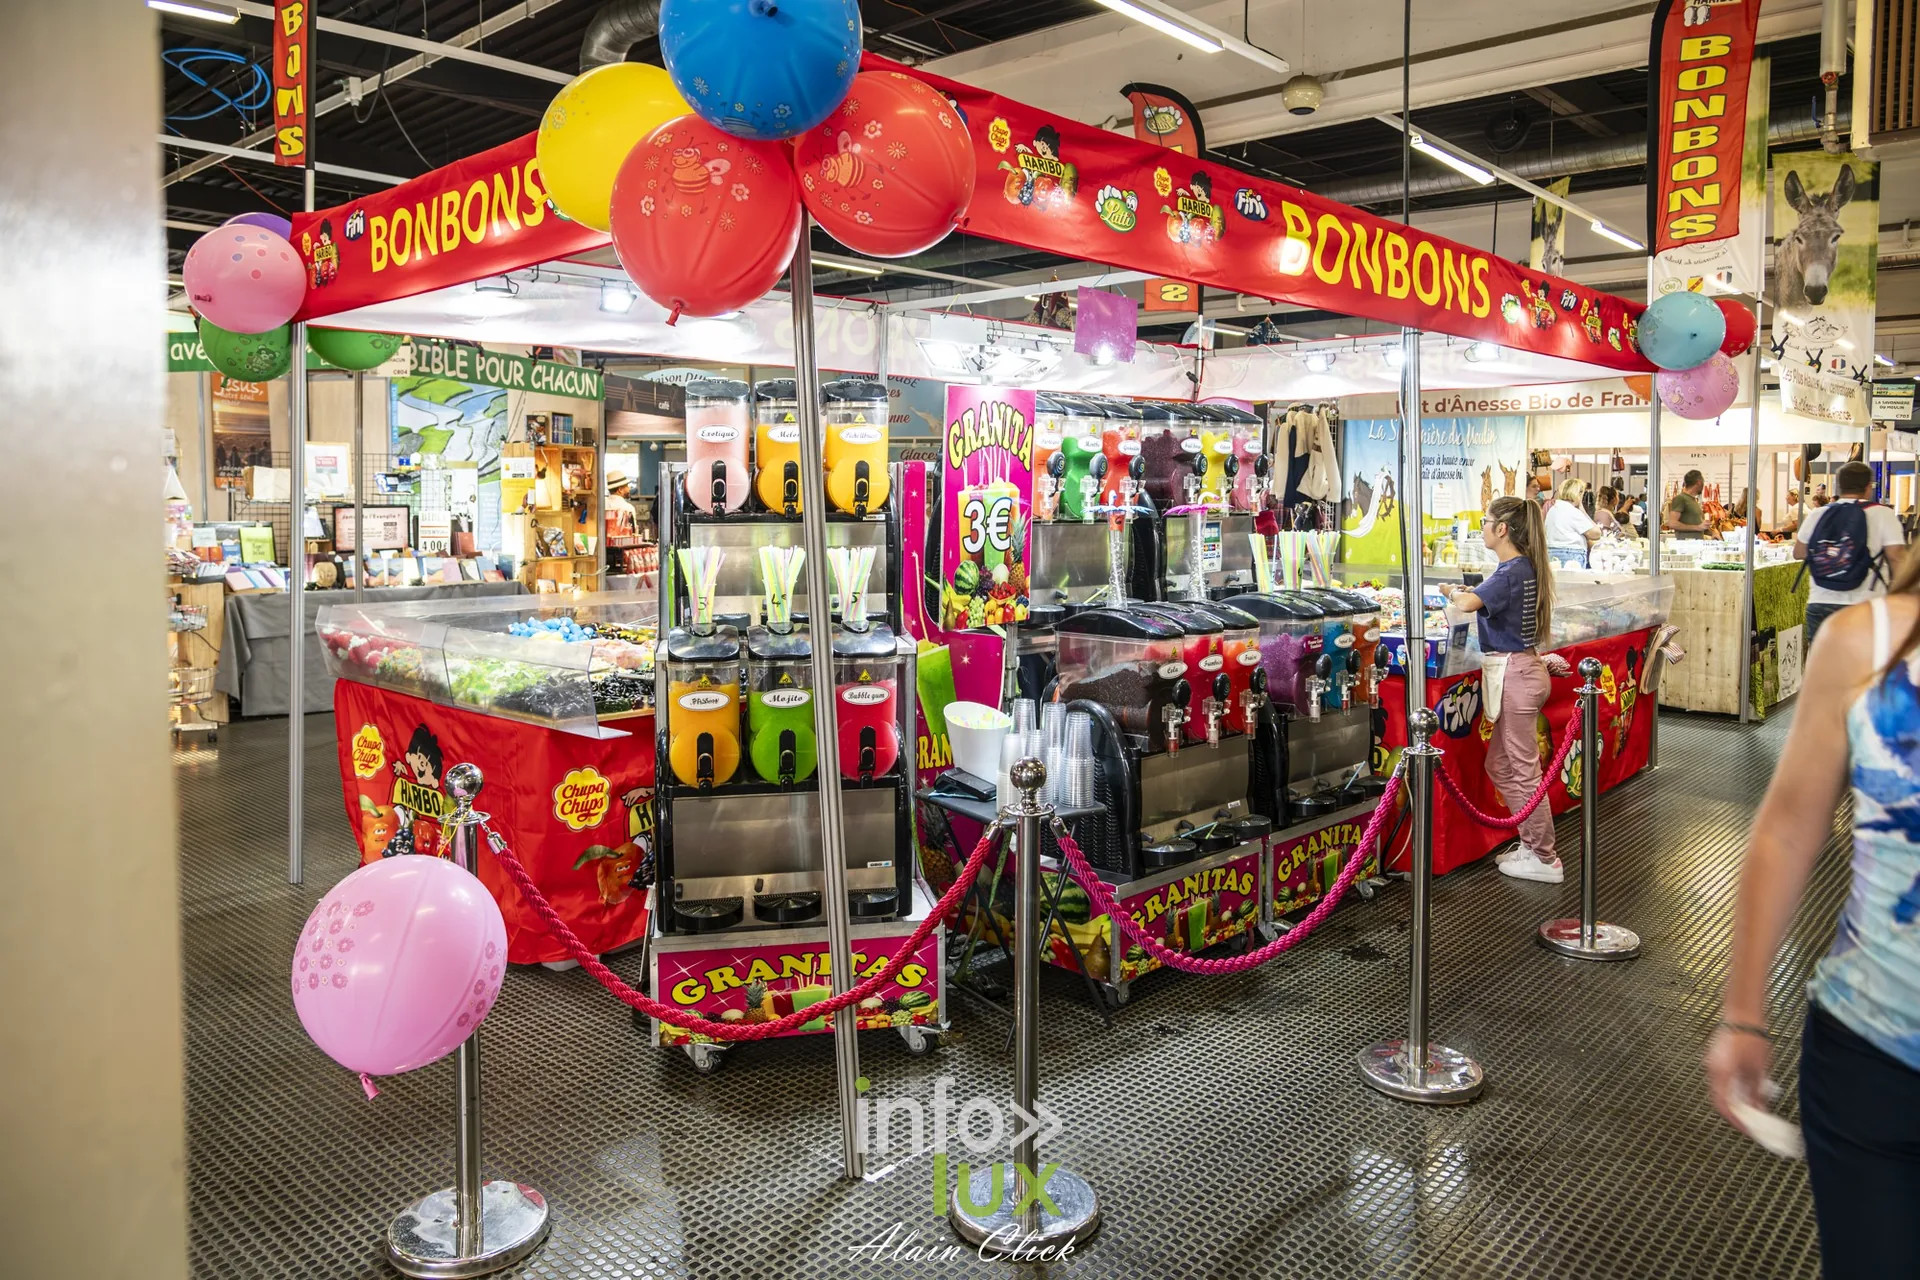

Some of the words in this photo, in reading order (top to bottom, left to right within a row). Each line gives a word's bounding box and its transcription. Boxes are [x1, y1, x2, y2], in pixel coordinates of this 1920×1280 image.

[1668, 34, 1732, 241] BONBONS
[1023, 154, 1062, 177] HARIBO
[369, 157, 545, 273] BONBONS
[1181, 197, 1211, 216] HARIBO
[1238, 190, 1266, 218] Fini
[346, 210, 365, 239] Fini
[1279, 200, 1491, 319] BONBONS
[410, 341, 469, 380] BIBLE
[475, 352, 525, 387] POUR
[531, 364, 598, 398] CHACUN
[1435, 394, 1522, 413] d'Ânesse
[1528, 394, 1561, 410] Bio
[1566, 392, 1593, 408] de
[700, 429, 735, 439] Exotique
[948, 400, 1034, 472] GRANITA
[962, 498, 1012, 554] 3€
[769, 694, 804, 705] Mojito
[847, 690, 870, 700] Bubble
[871, 693, 885, 702] gum
[356, 735, 382, 751] Chupa
[352, 748, 381, 770] Chups
[400, 780, 441, 816] HARIBO
[561, 782, 605, 800] Chupa
[560, 797, 604, 822] Chups
